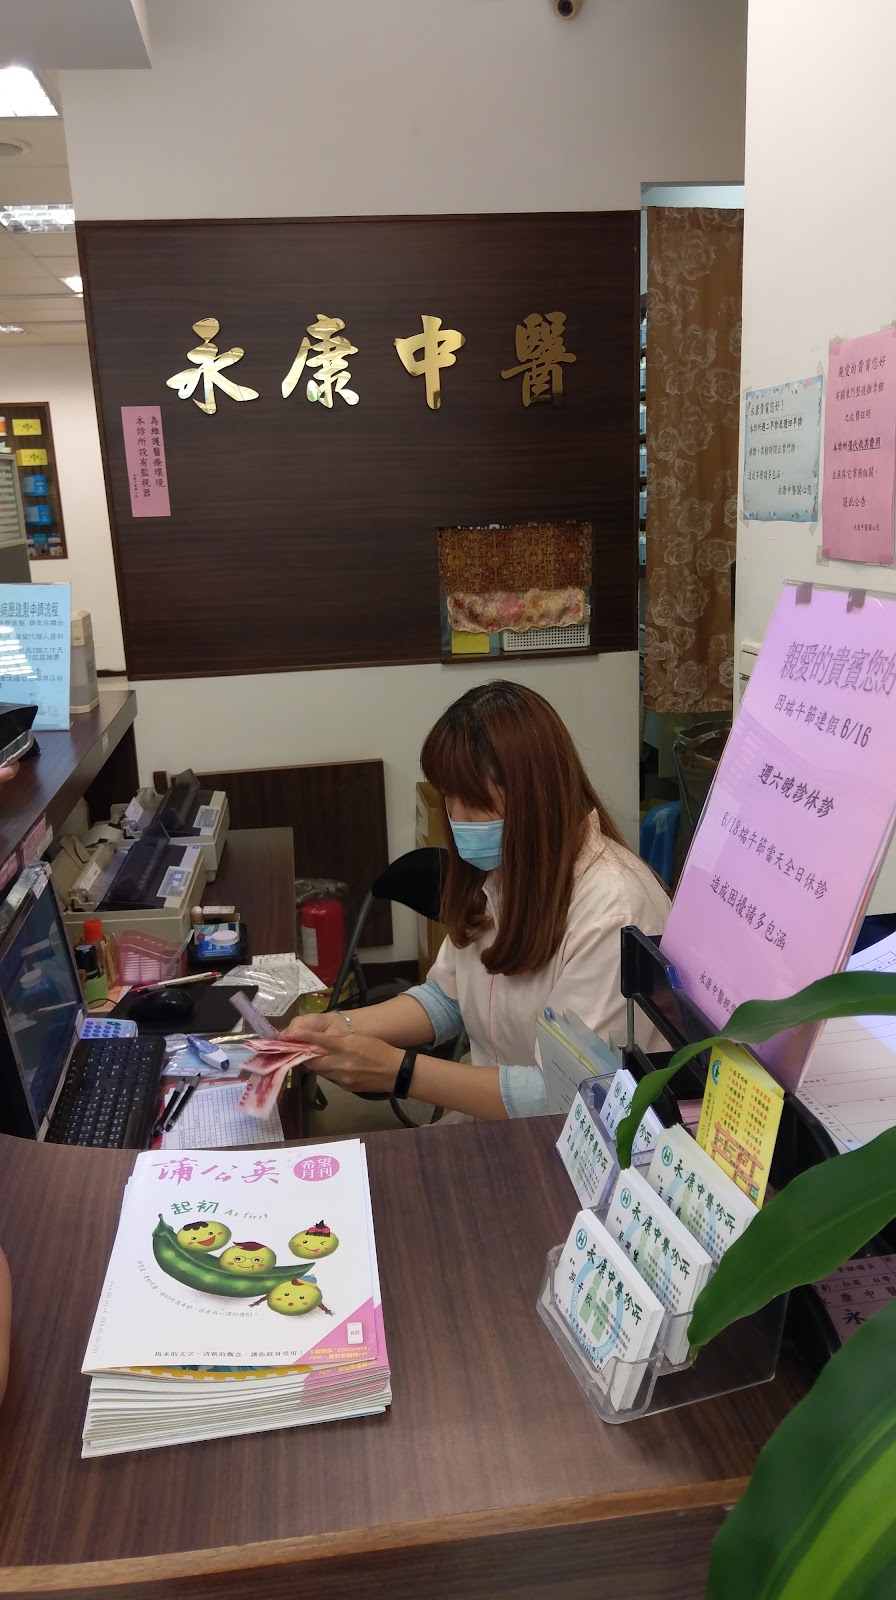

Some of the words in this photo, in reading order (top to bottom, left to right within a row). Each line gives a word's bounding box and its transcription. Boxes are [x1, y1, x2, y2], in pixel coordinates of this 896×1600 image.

[166, 312, 577, 414] 永康中醫
[838, 355, 886, 378] 親愛的貴賓您好
[136, 416, 151, 498] 本診所設有監視器
[150, 415, 165, 488] 為維護醫療環境
[758, 763, 834, 818] 週六晚診休診
[709, 874, 786, 951] 造成困擾請多包涵
[151, 1157, 279, 1185] 蒲公英
[301, 1158, 332, 1169] 希望
[301, 1168, 332, 1179] 月刊
[171, 1200, 219, 1215] 起初
[673, 1159, 736, 1234] 永康中醫診所
[632, 1201, 690, 1280] 永康中醫診所
[586, 1243, 643, 1326] 永康中醫診所
[350, 1329, 360, 1337] AR
